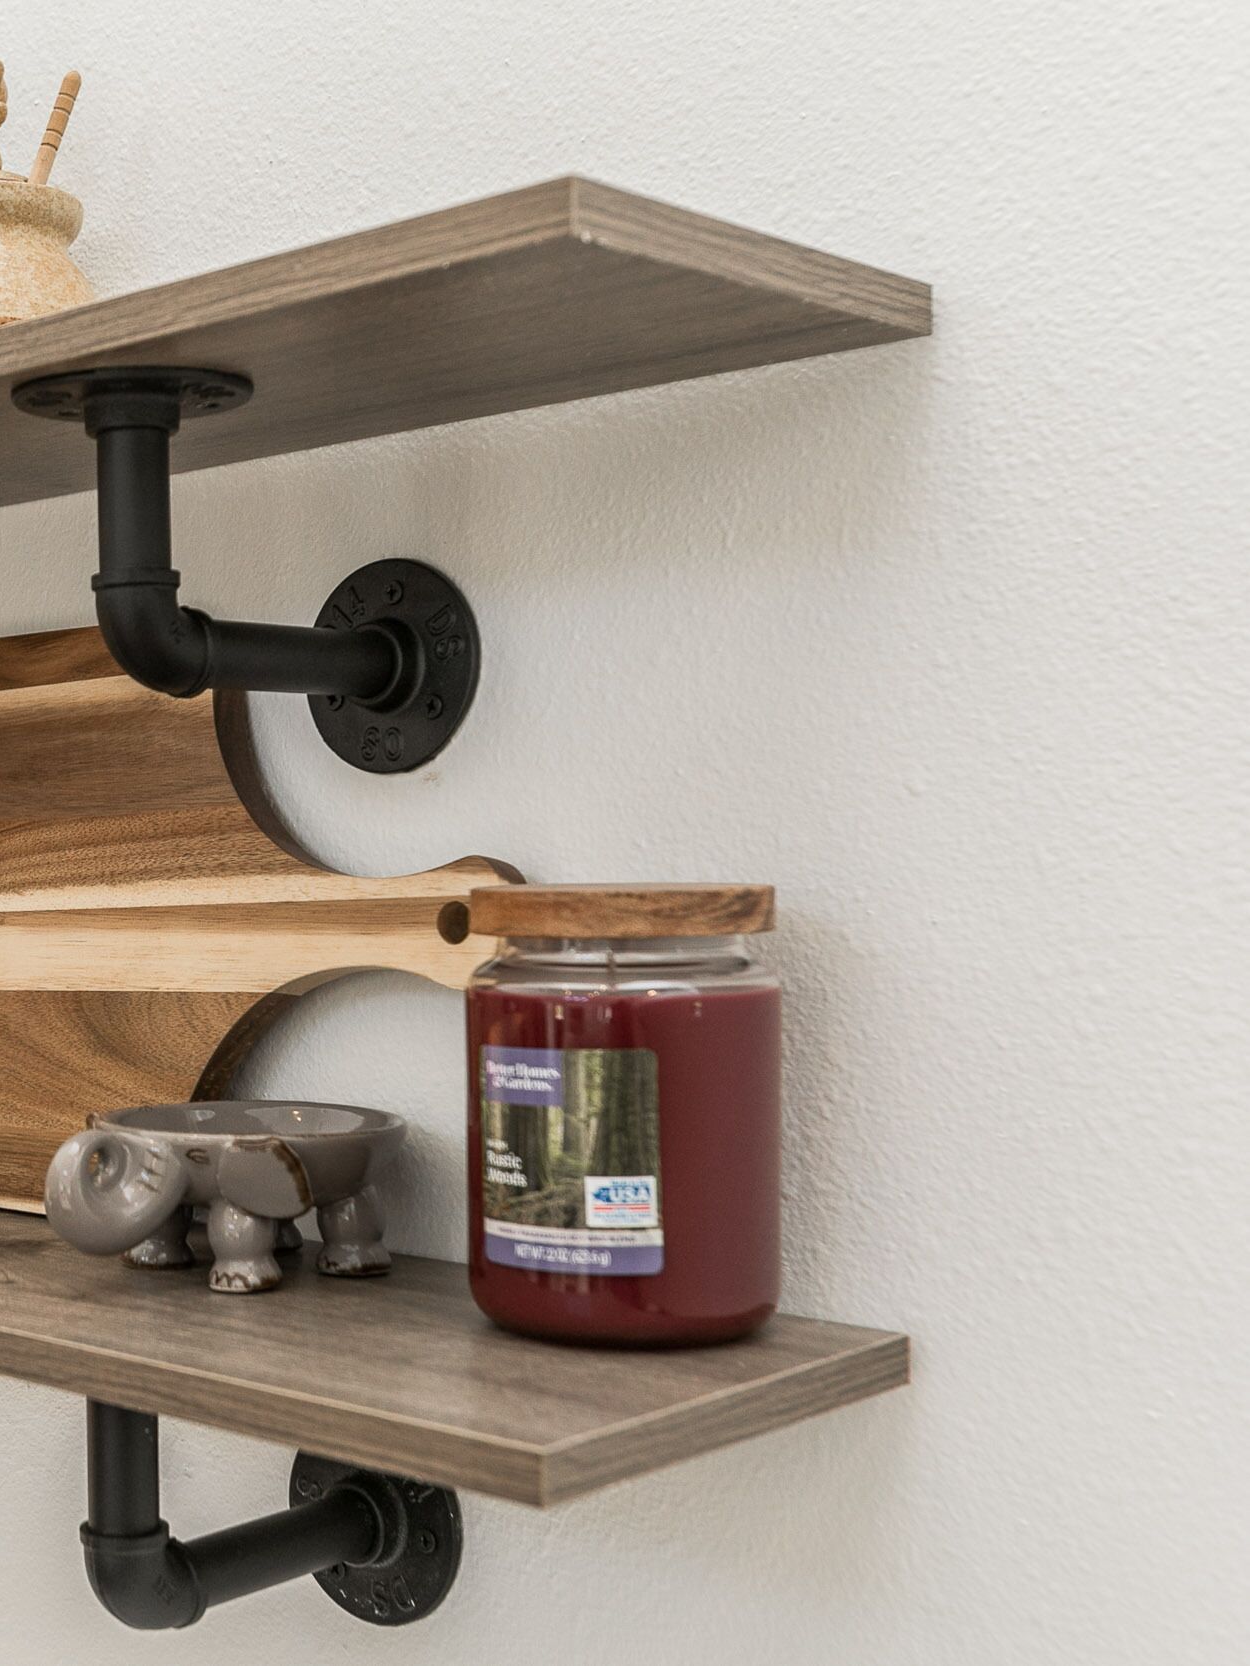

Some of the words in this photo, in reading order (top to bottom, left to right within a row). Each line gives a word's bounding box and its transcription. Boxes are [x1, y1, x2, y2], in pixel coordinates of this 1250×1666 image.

[486, 1149, 523, 1170] Rustic
[486, 1167, 528, 1187] Woods
[610, 1187, 650, 1202] USA
